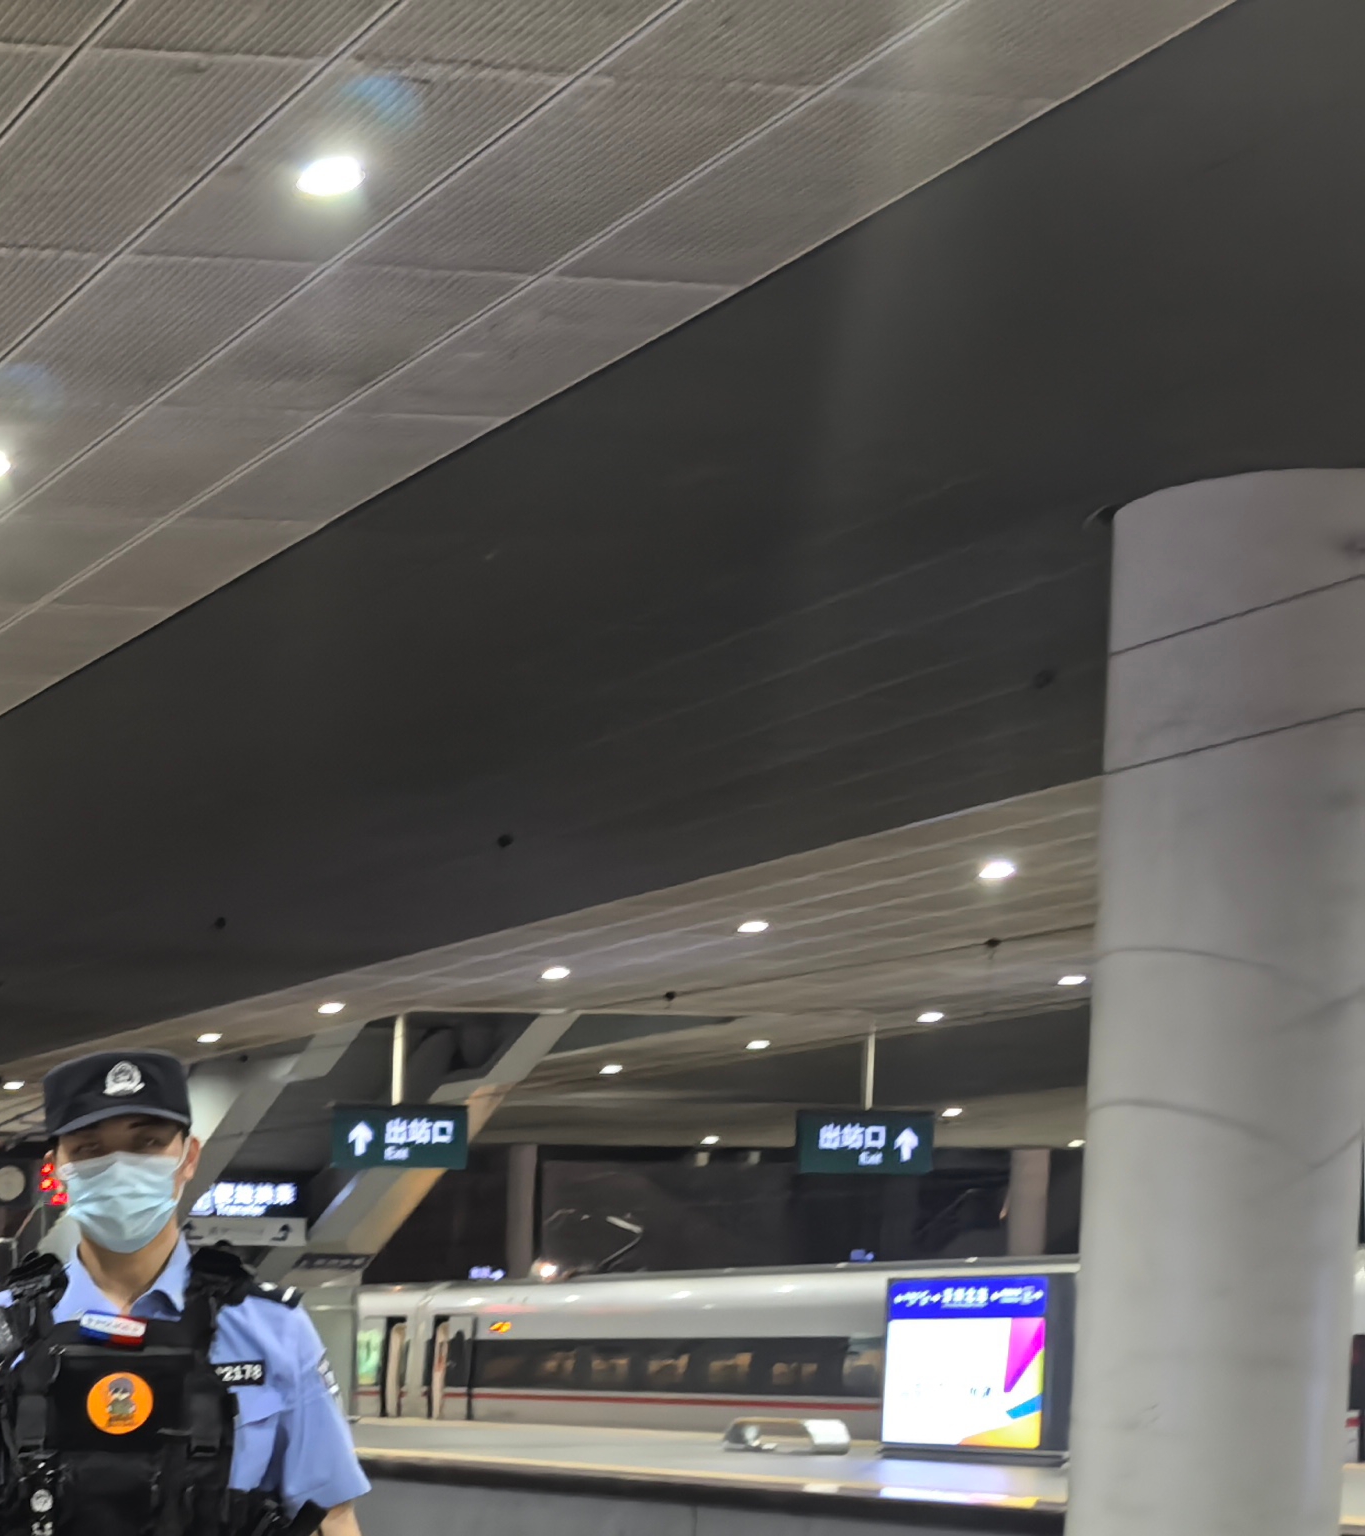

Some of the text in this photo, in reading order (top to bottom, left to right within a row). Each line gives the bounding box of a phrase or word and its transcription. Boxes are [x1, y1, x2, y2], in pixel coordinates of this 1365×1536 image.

[384, 1117, 454, 1144] 出站口
[818, 1122, 886, 1149] 出站口
